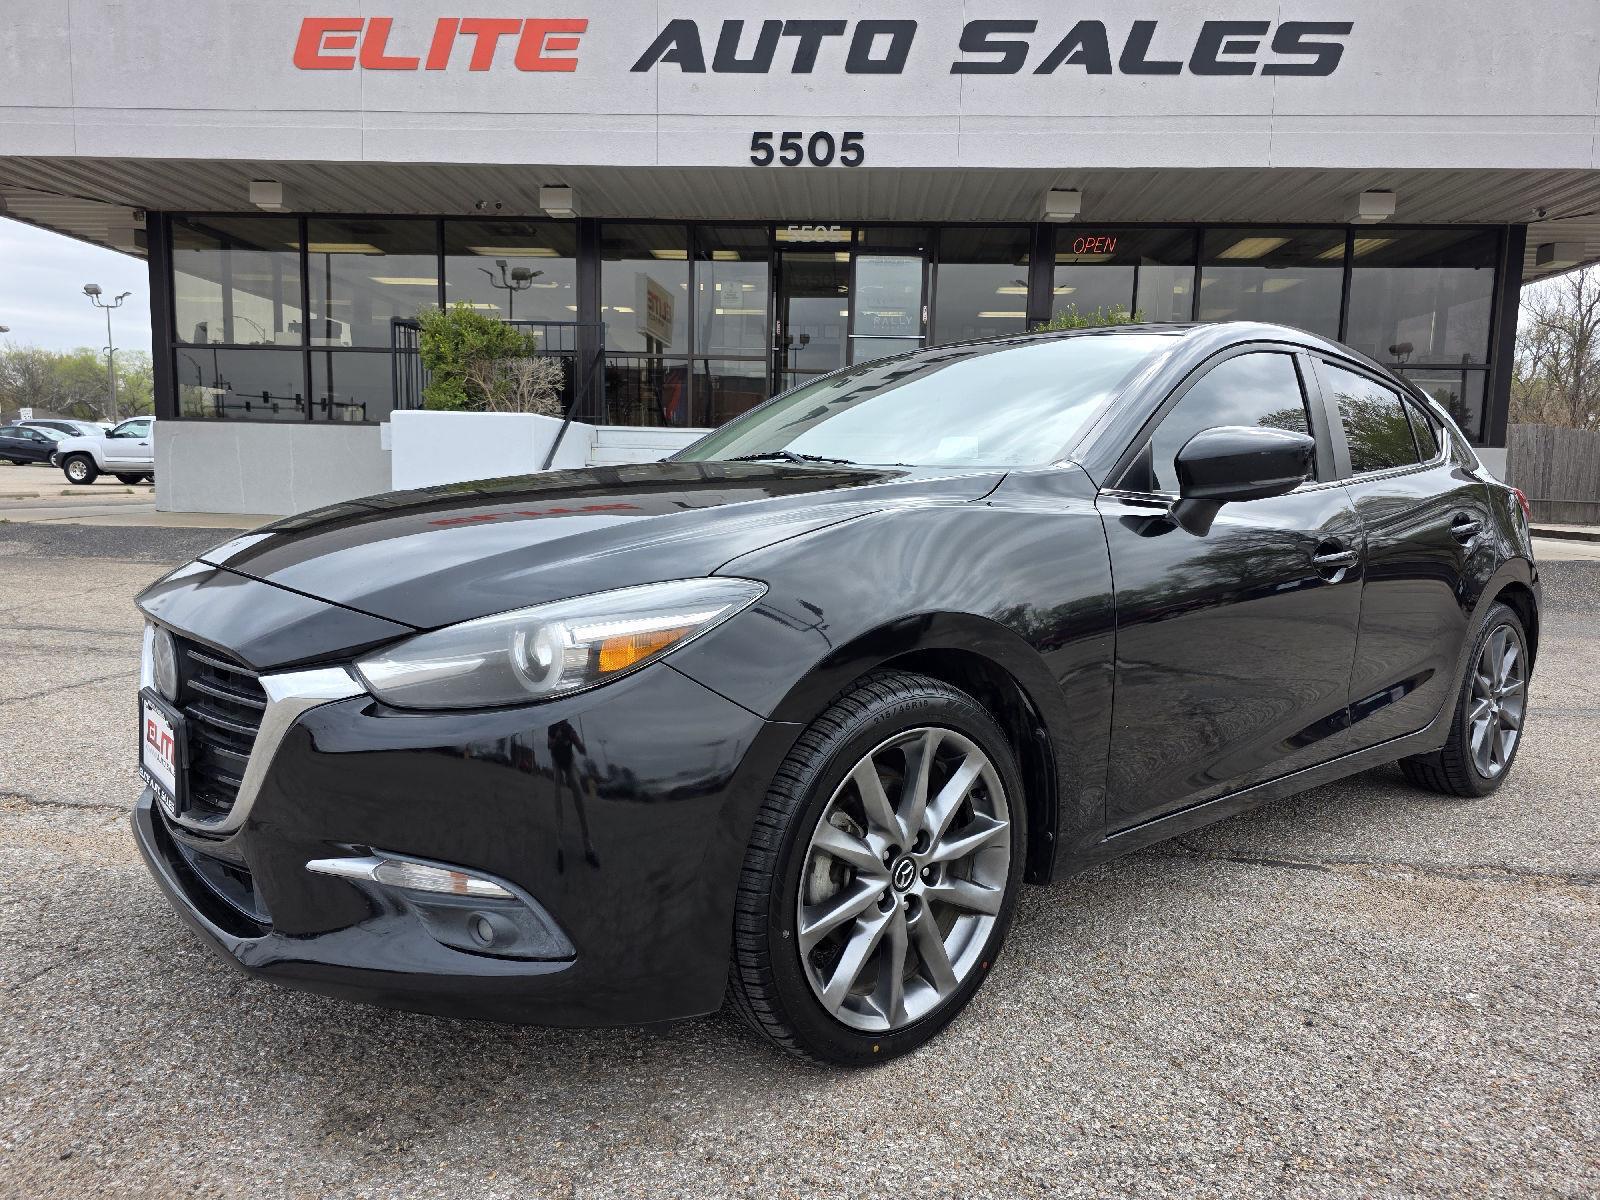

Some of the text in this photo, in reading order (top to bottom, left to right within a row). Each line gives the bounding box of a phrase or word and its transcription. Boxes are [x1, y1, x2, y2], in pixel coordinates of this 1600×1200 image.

[293, 17, 1355, 76] ELITE AUTO SALES
[750, 131, 865, 167] 5505
[1073, 237, 1117, 254] OPEN
